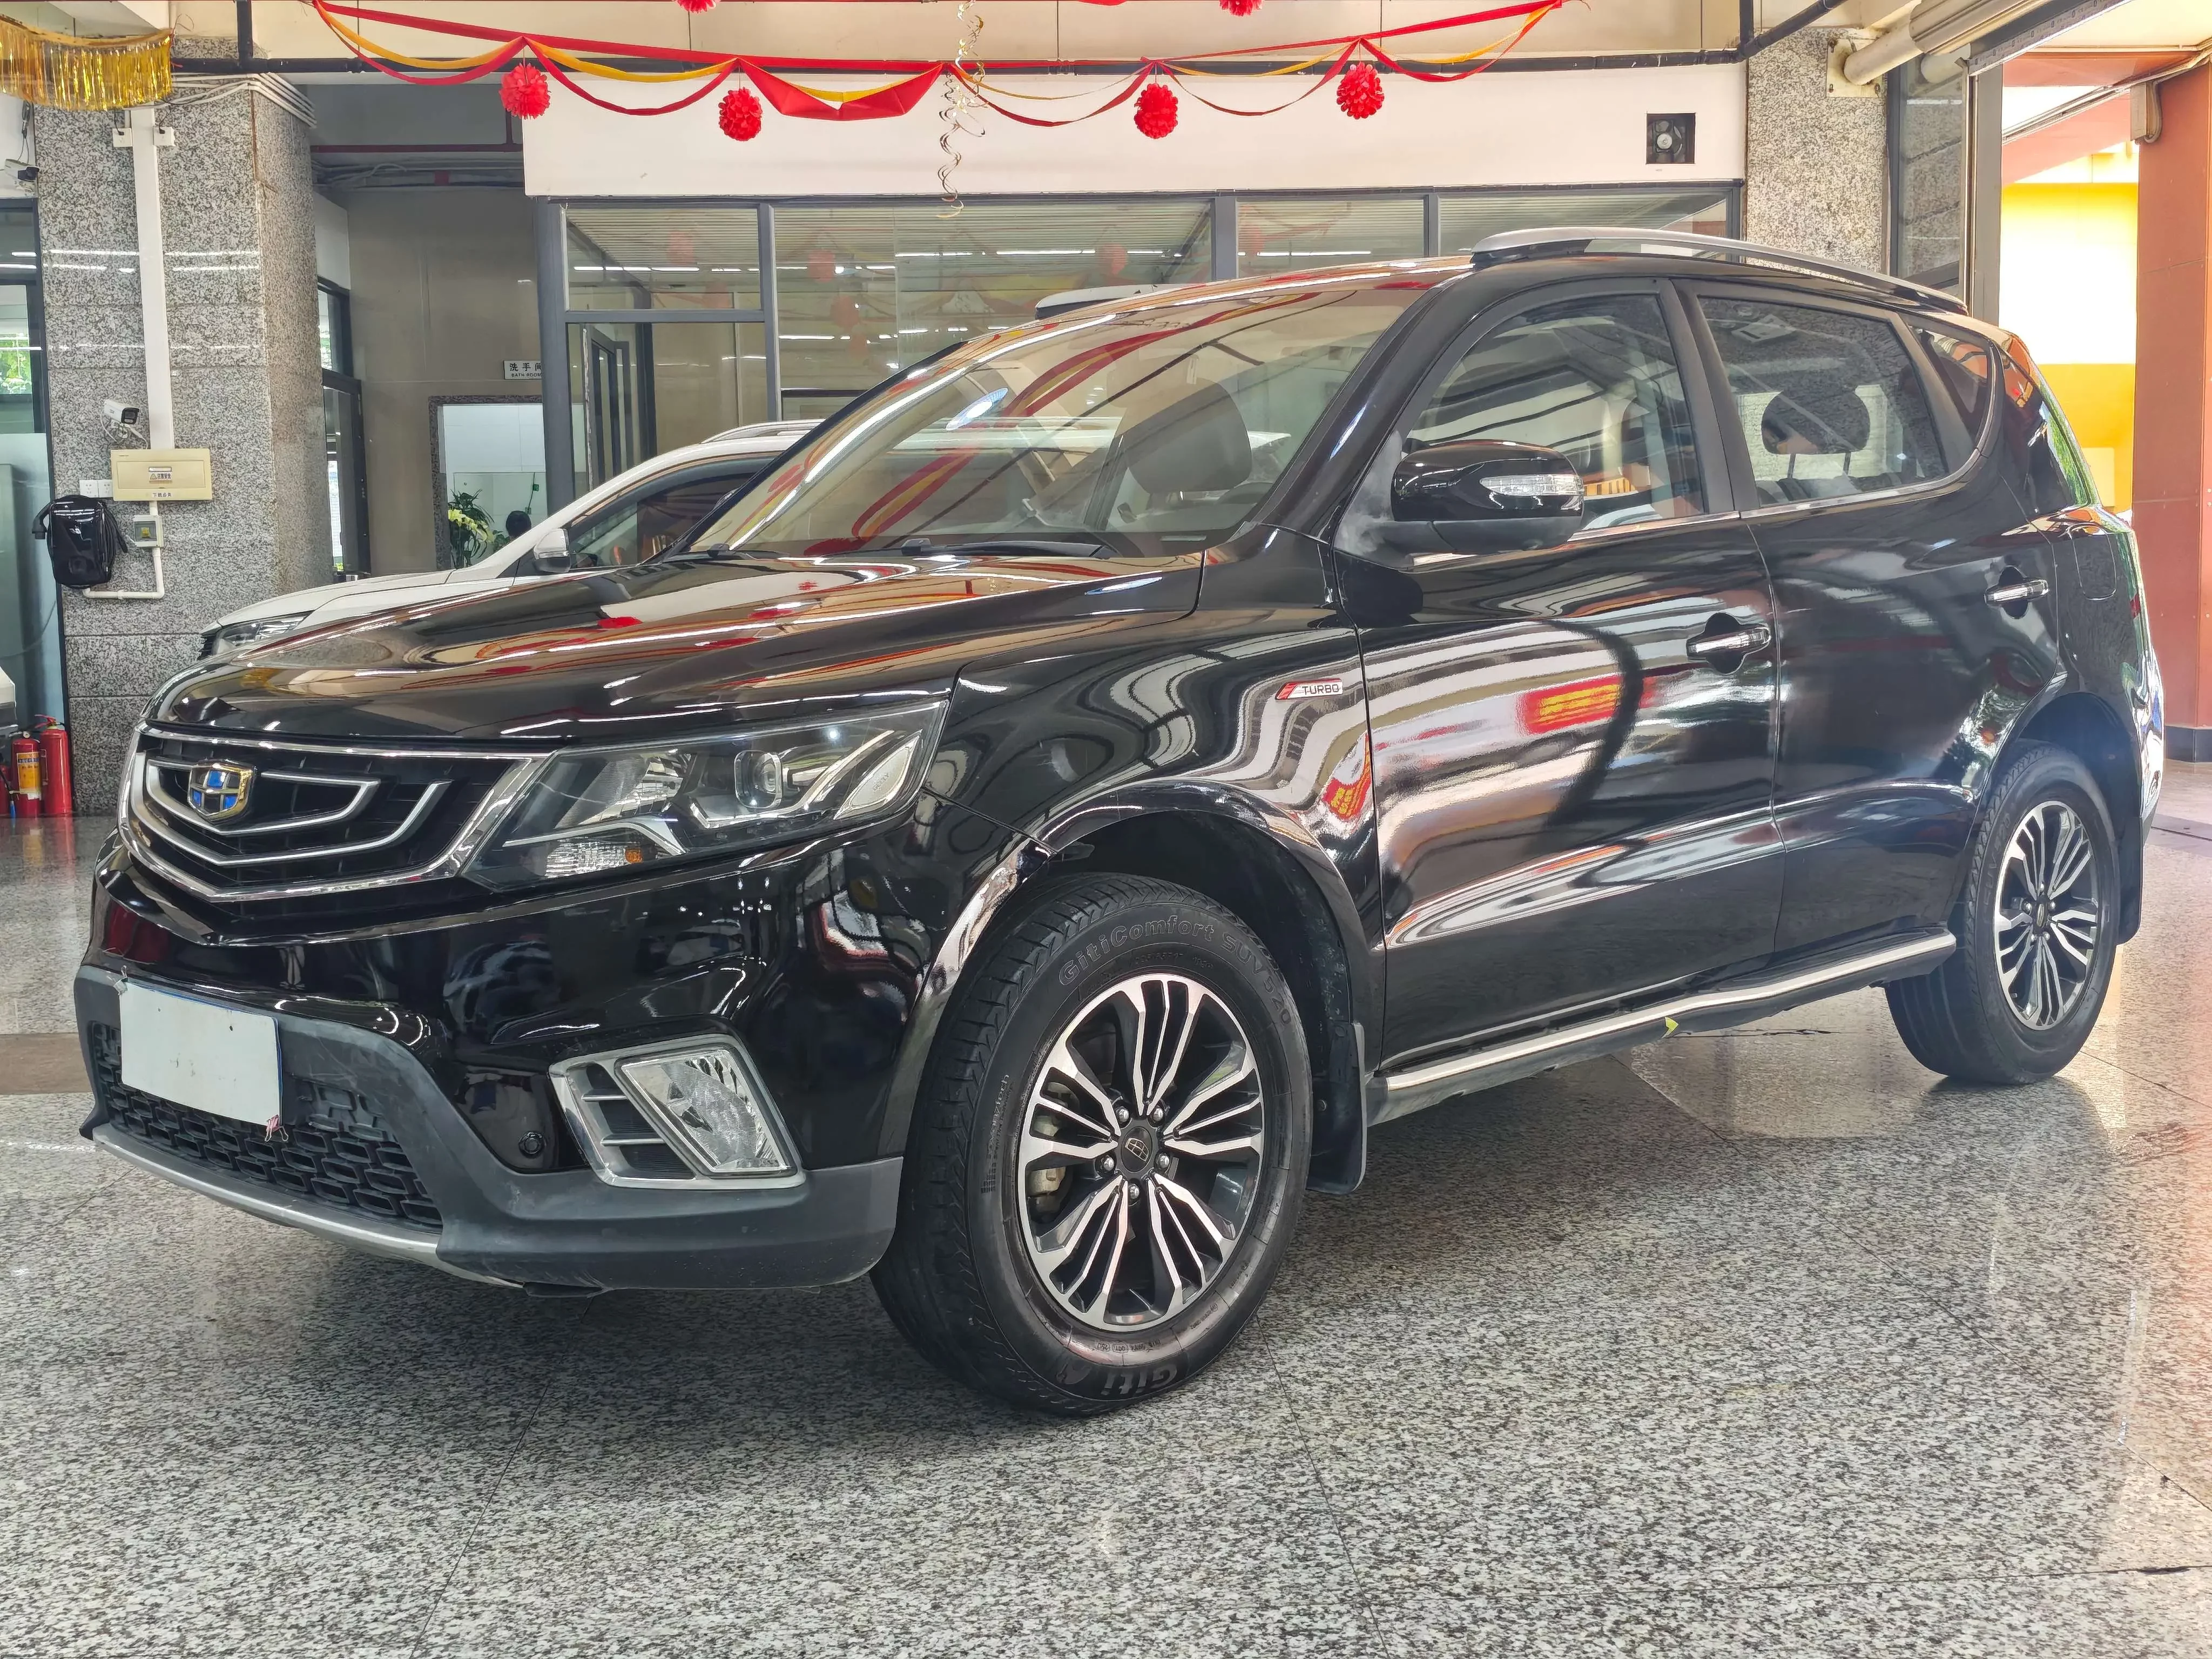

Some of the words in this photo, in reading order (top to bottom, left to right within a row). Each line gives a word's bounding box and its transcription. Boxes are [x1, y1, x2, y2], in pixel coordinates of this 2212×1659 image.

[1302, 684, 1340, 695] TURBO
[1058, 915, 1215, 986] GitiComfort
[1220, 932, 1268, 976] SUV
[1264, 974, 1292, 1025] 520
[1100, 1364, 1177, 1396] Giti
